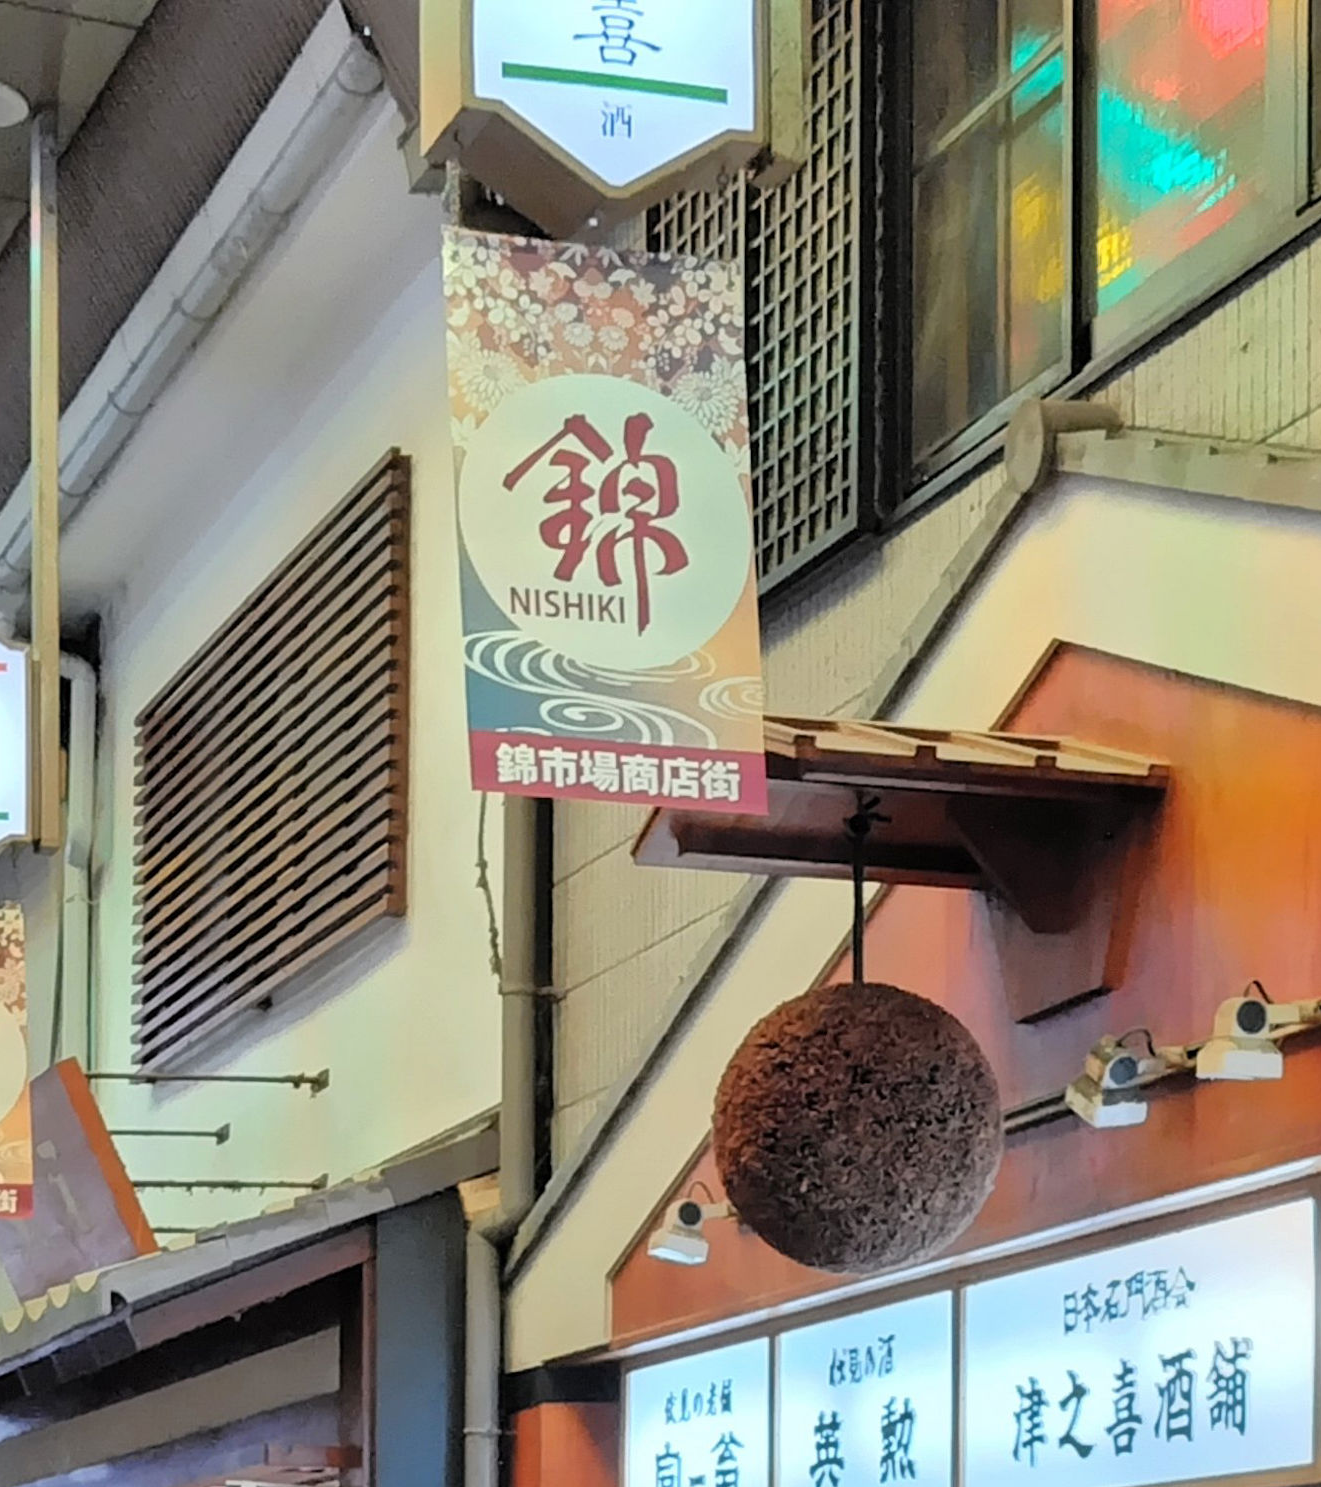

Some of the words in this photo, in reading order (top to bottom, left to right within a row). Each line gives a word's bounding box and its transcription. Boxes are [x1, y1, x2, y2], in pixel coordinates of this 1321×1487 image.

[503, 413, 689, 636] 錦
[509, 586, 627, 625] NISHIKI
[496, 741, 742, 803] 錦市場商店街
